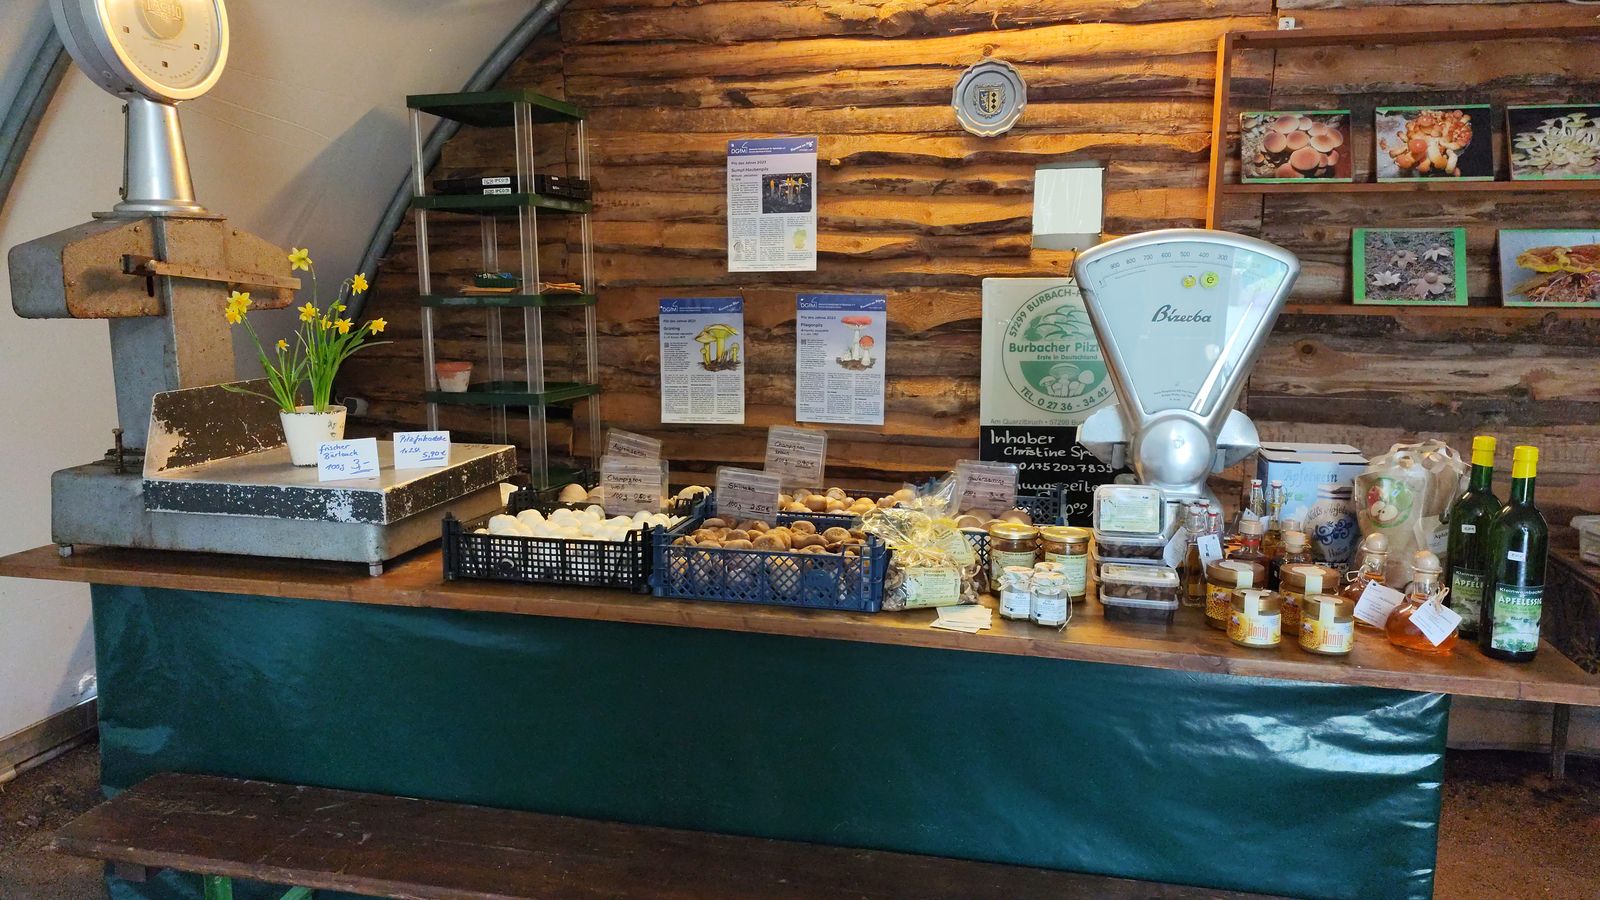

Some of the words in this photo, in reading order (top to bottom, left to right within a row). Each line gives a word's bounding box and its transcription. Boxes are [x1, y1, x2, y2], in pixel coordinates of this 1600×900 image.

[1152, 304, 1212, 322] Bizerba
[1009, 311, 1027, 338] 57299
[1009, 342, 1070, 352] Burbacher
[1020, 387, 1034, 402] TEL.
[1083, 396, 1096, 407] 34
[1098, 386, 1109, 398] 42
[991, 429, 1056, 445] Inhaber
[320, 444, 350, 454] frischer
[1004, 446, 1067, 457] Christine
[1248, 619, 1269, 641] Honig
[1323, 626, 1344, 648] Honig
